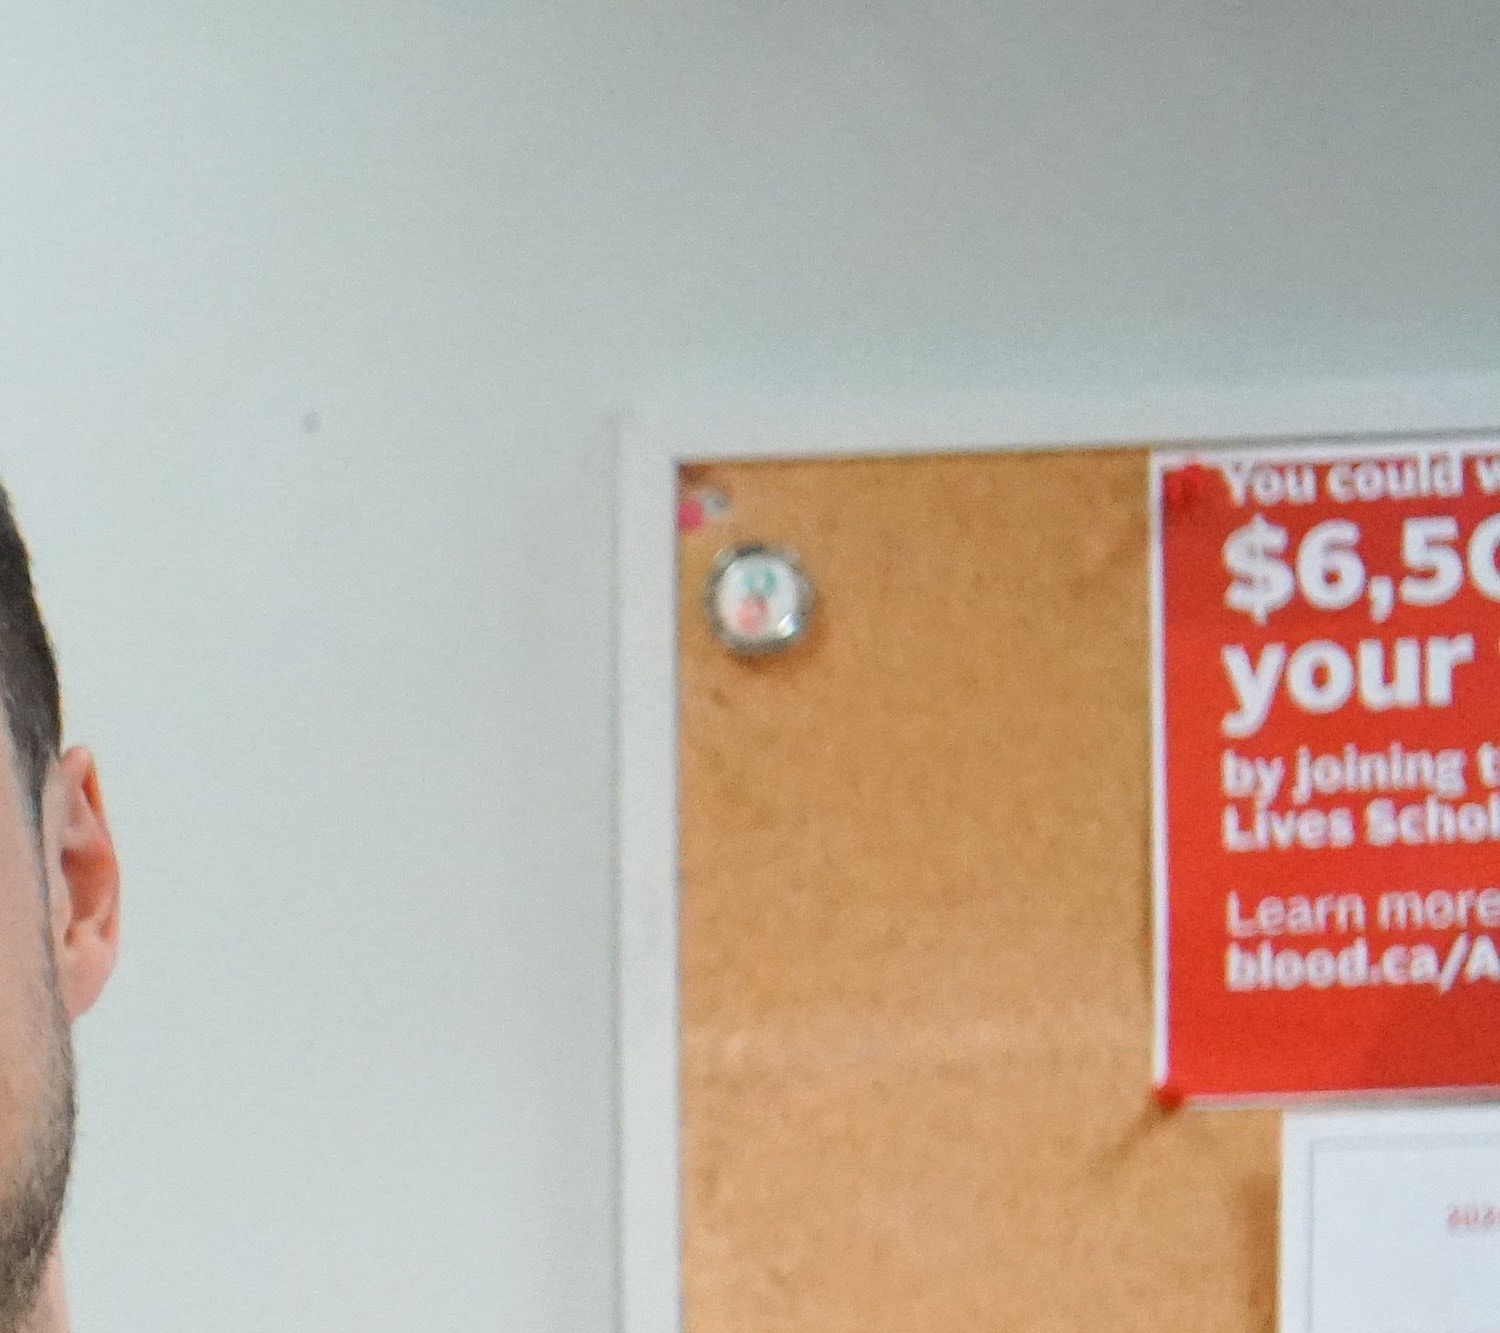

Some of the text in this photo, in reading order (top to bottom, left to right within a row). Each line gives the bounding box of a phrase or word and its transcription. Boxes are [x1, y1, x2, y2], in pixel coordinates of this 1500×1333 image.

[1220, 458, 1317, 508] You
[1326, 451, 1464, 503] could
[1220, 632, 1475, 740] your
[1223, 748, 1285, 812] by
[1292, 741, 1468, 804] joining
[1224, 804, 1355, 853] Lives
[1227, 887, 1500, 937] Learn more
